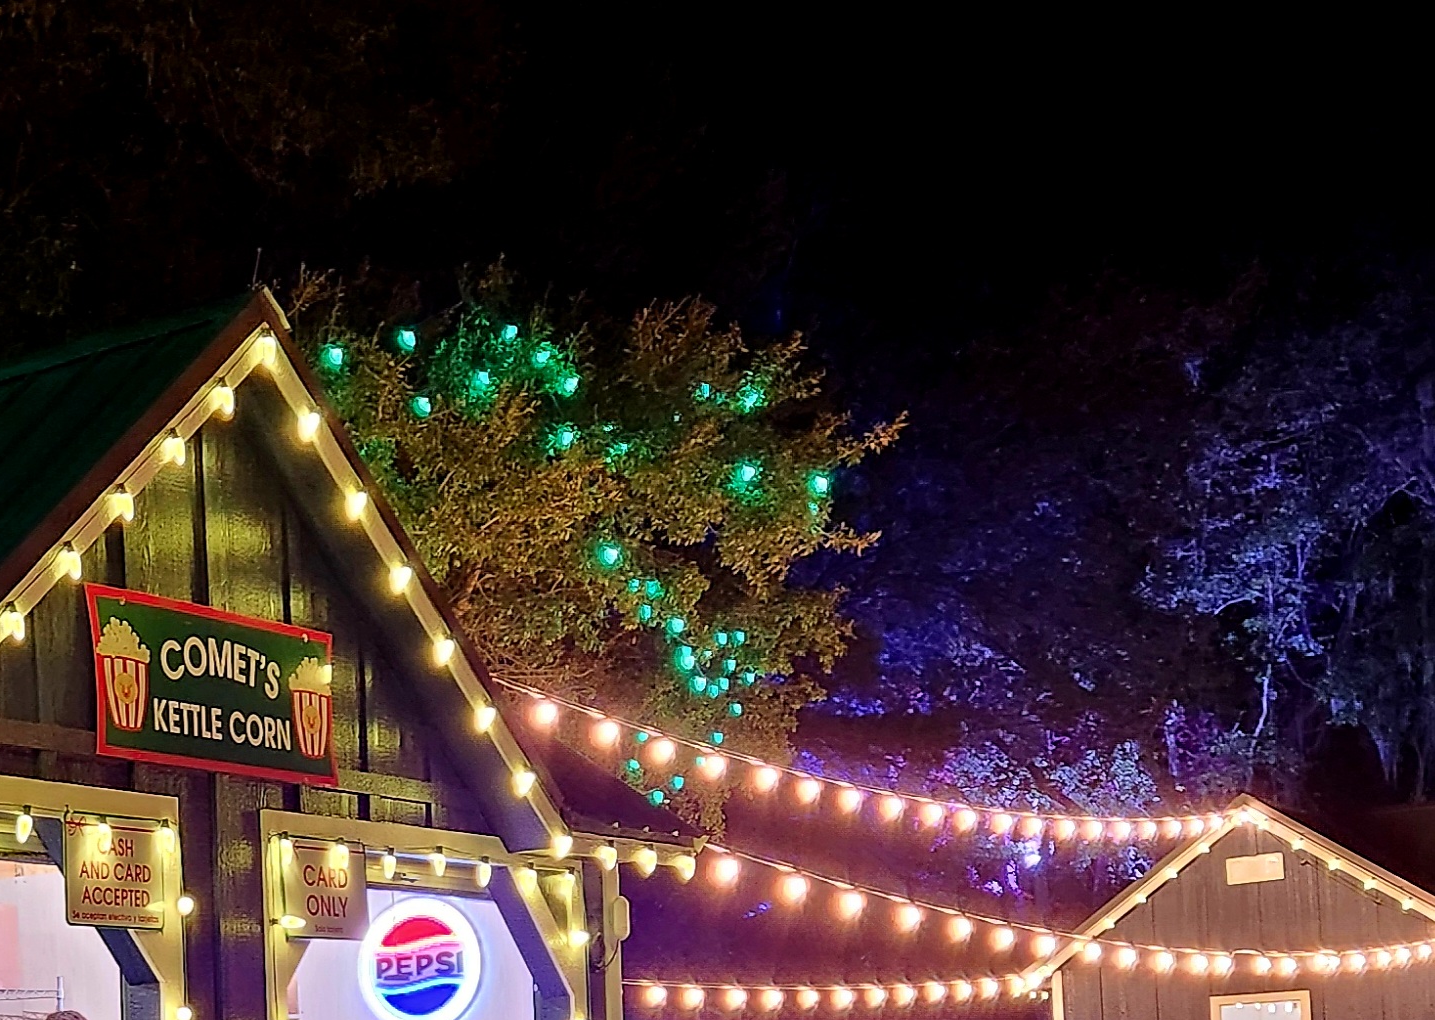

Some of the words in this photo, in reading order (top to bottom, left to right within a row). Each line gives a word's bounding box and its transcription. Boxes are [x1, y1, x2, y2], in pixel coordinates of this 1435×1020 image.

[160, 635, 281, 700] COMET'S
[152, 697, 224, 742] KETTLE
[229, 711, 292, 751] CORN
[79, 860, 110, 880] AND
[113, 862, 152, 883] CARD
[302, 864, 349, 889] CARD
[81, 885, 151, 908] ACCEPTED
[306, 894, 349, 918] ONLY
[376, 951, 464, 980] PEPSI
